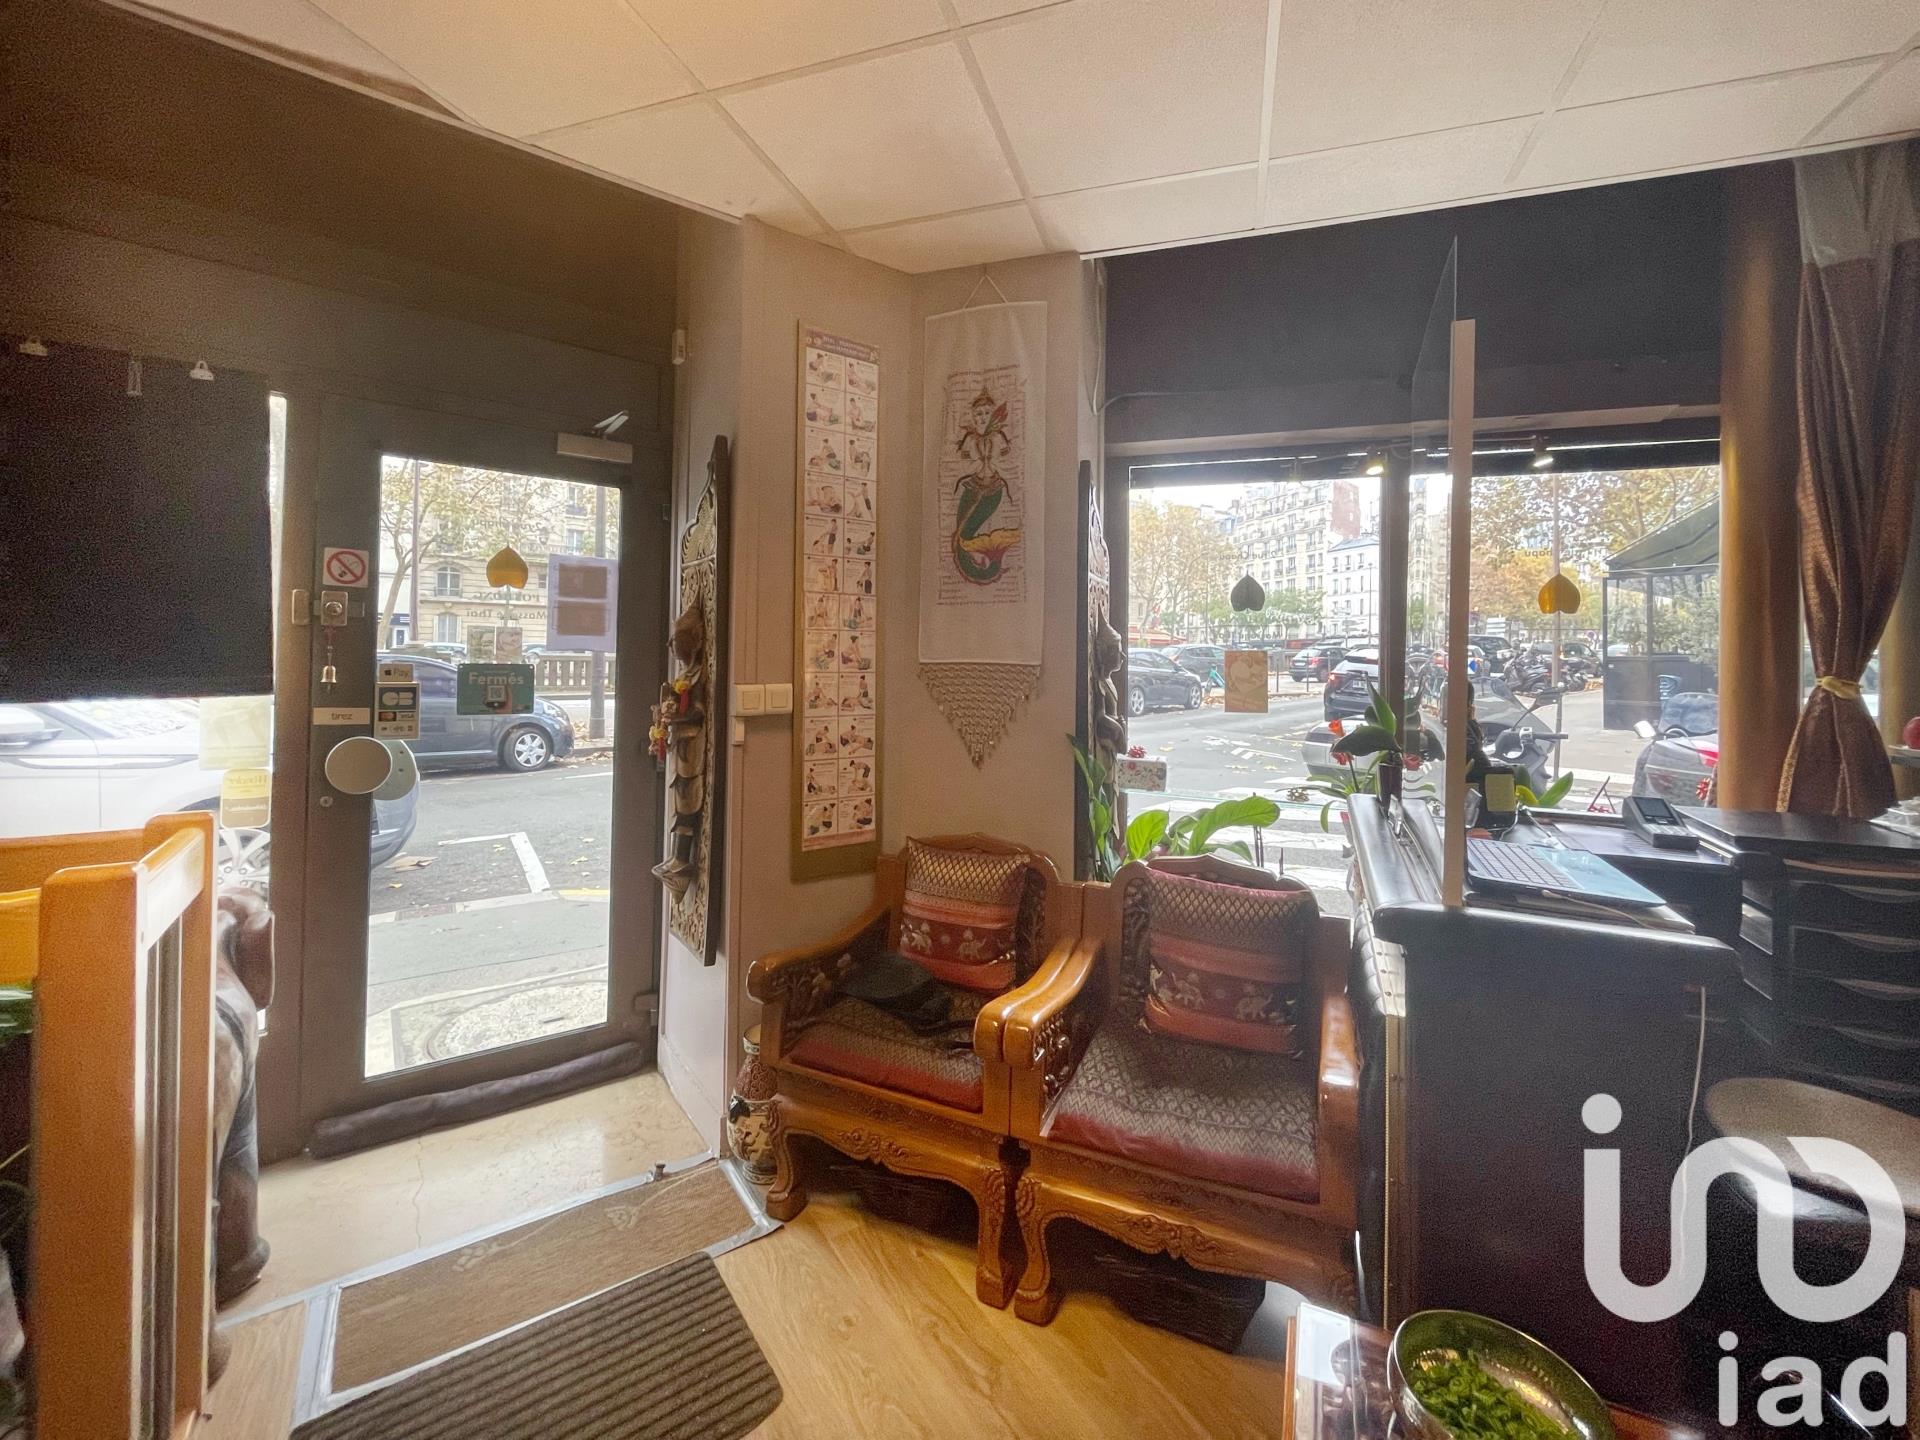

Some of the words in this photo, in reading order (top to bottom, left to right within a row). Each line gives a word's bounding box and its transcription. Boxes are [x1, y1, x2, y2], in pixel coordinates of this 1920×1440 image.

[394, 668, 411, 679] Pay
[468, 671, 525, 685] Fermés
[330, 713, 353, 721] tirez
